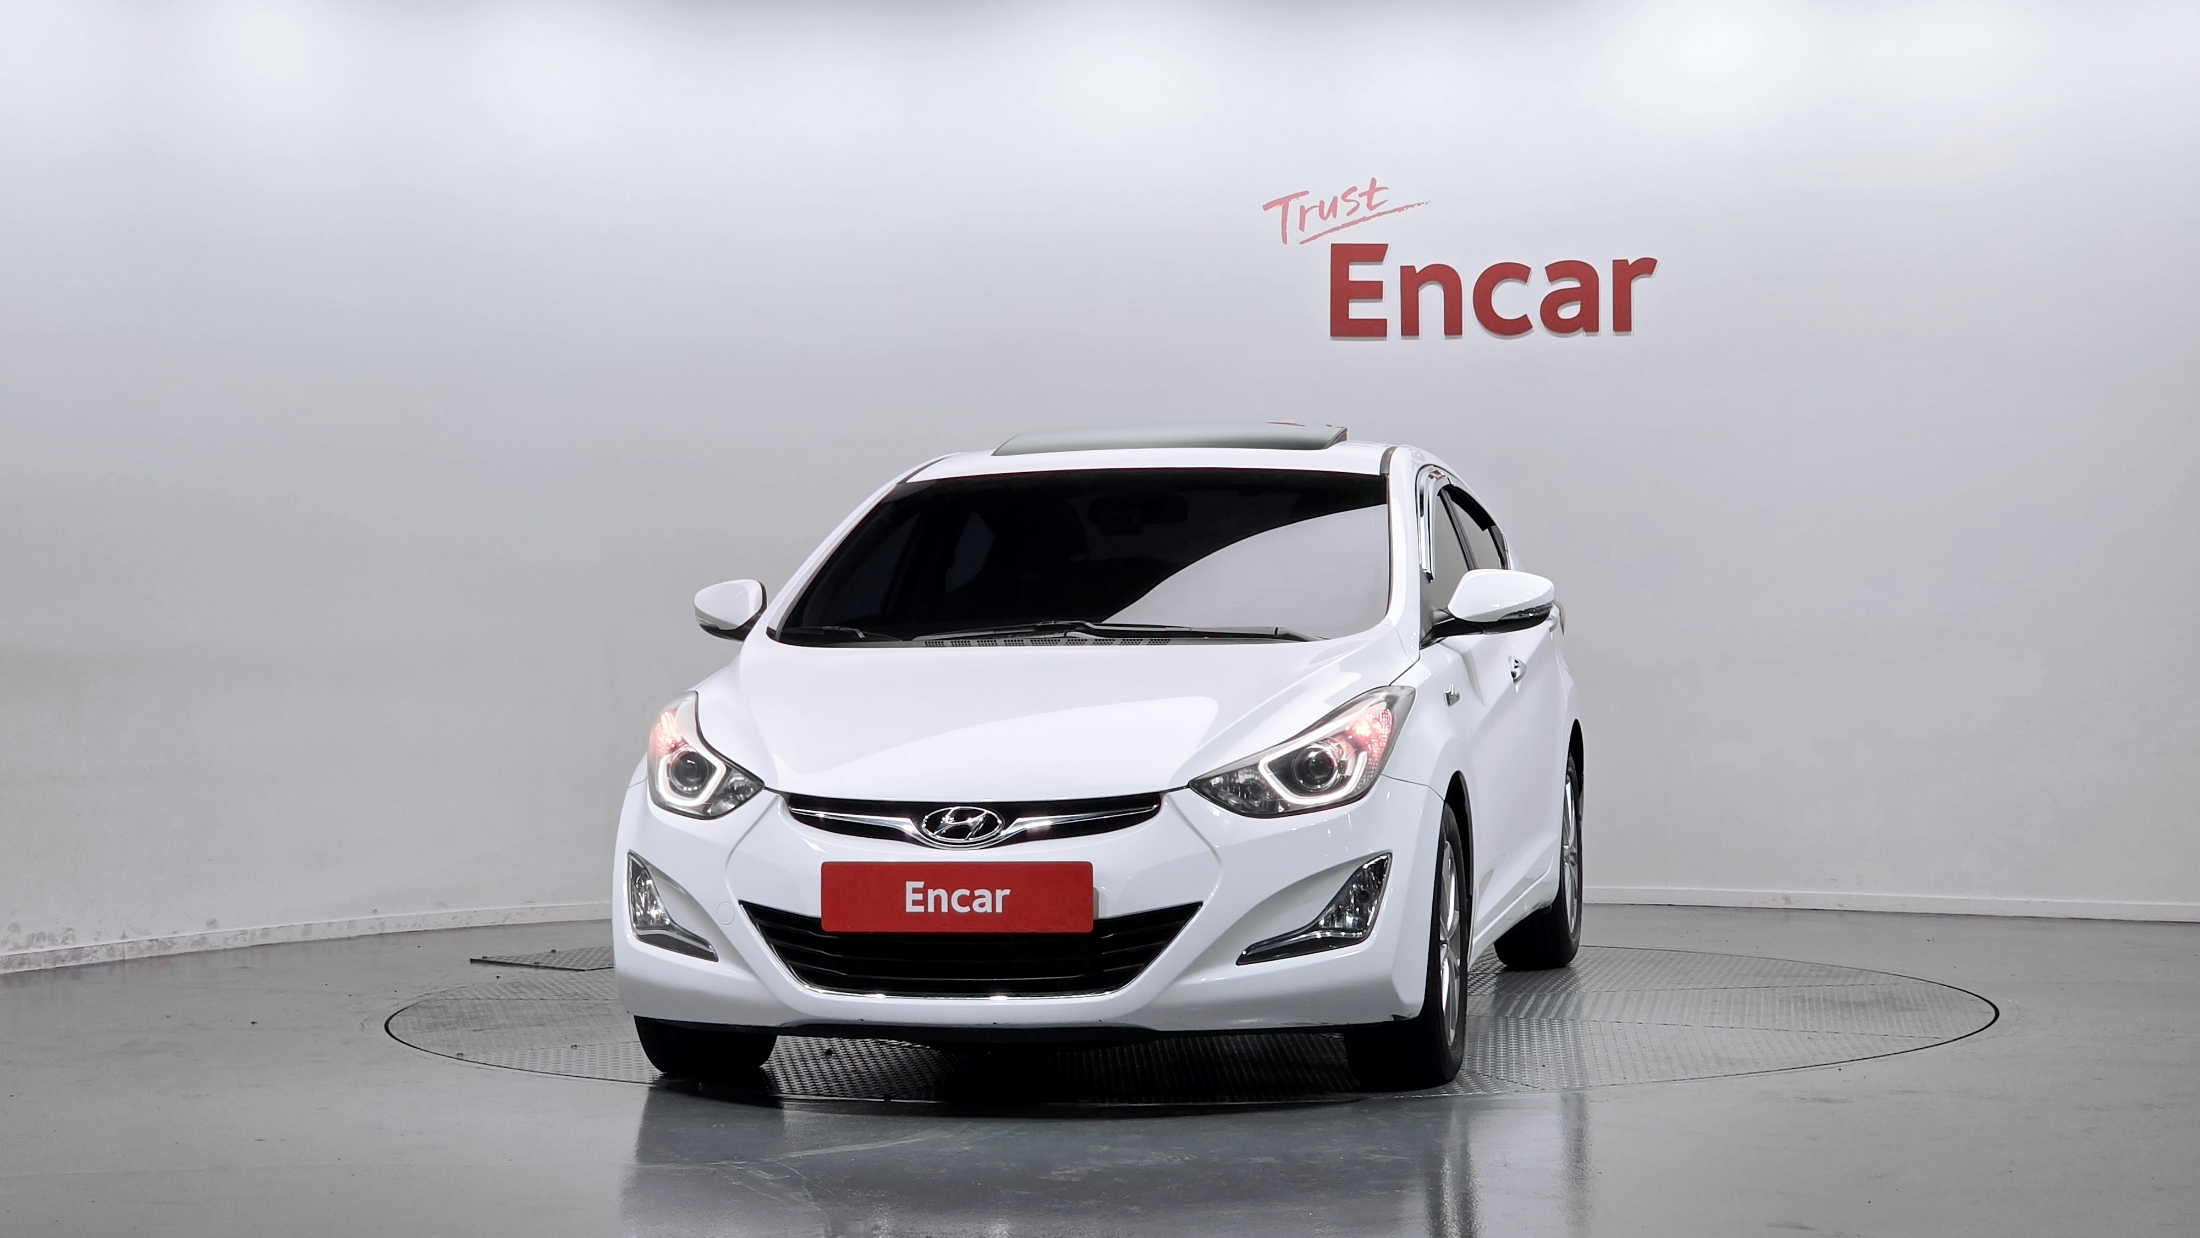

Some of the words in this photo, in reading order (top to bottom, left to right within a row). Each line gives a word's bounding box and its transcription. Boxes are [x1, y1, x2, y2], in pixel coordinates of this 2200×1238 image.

[1262, 177, 1390, 245] Trust
[1329, 243, 1658, 339] Encar
[904, 880, 1011, 914] Encar
